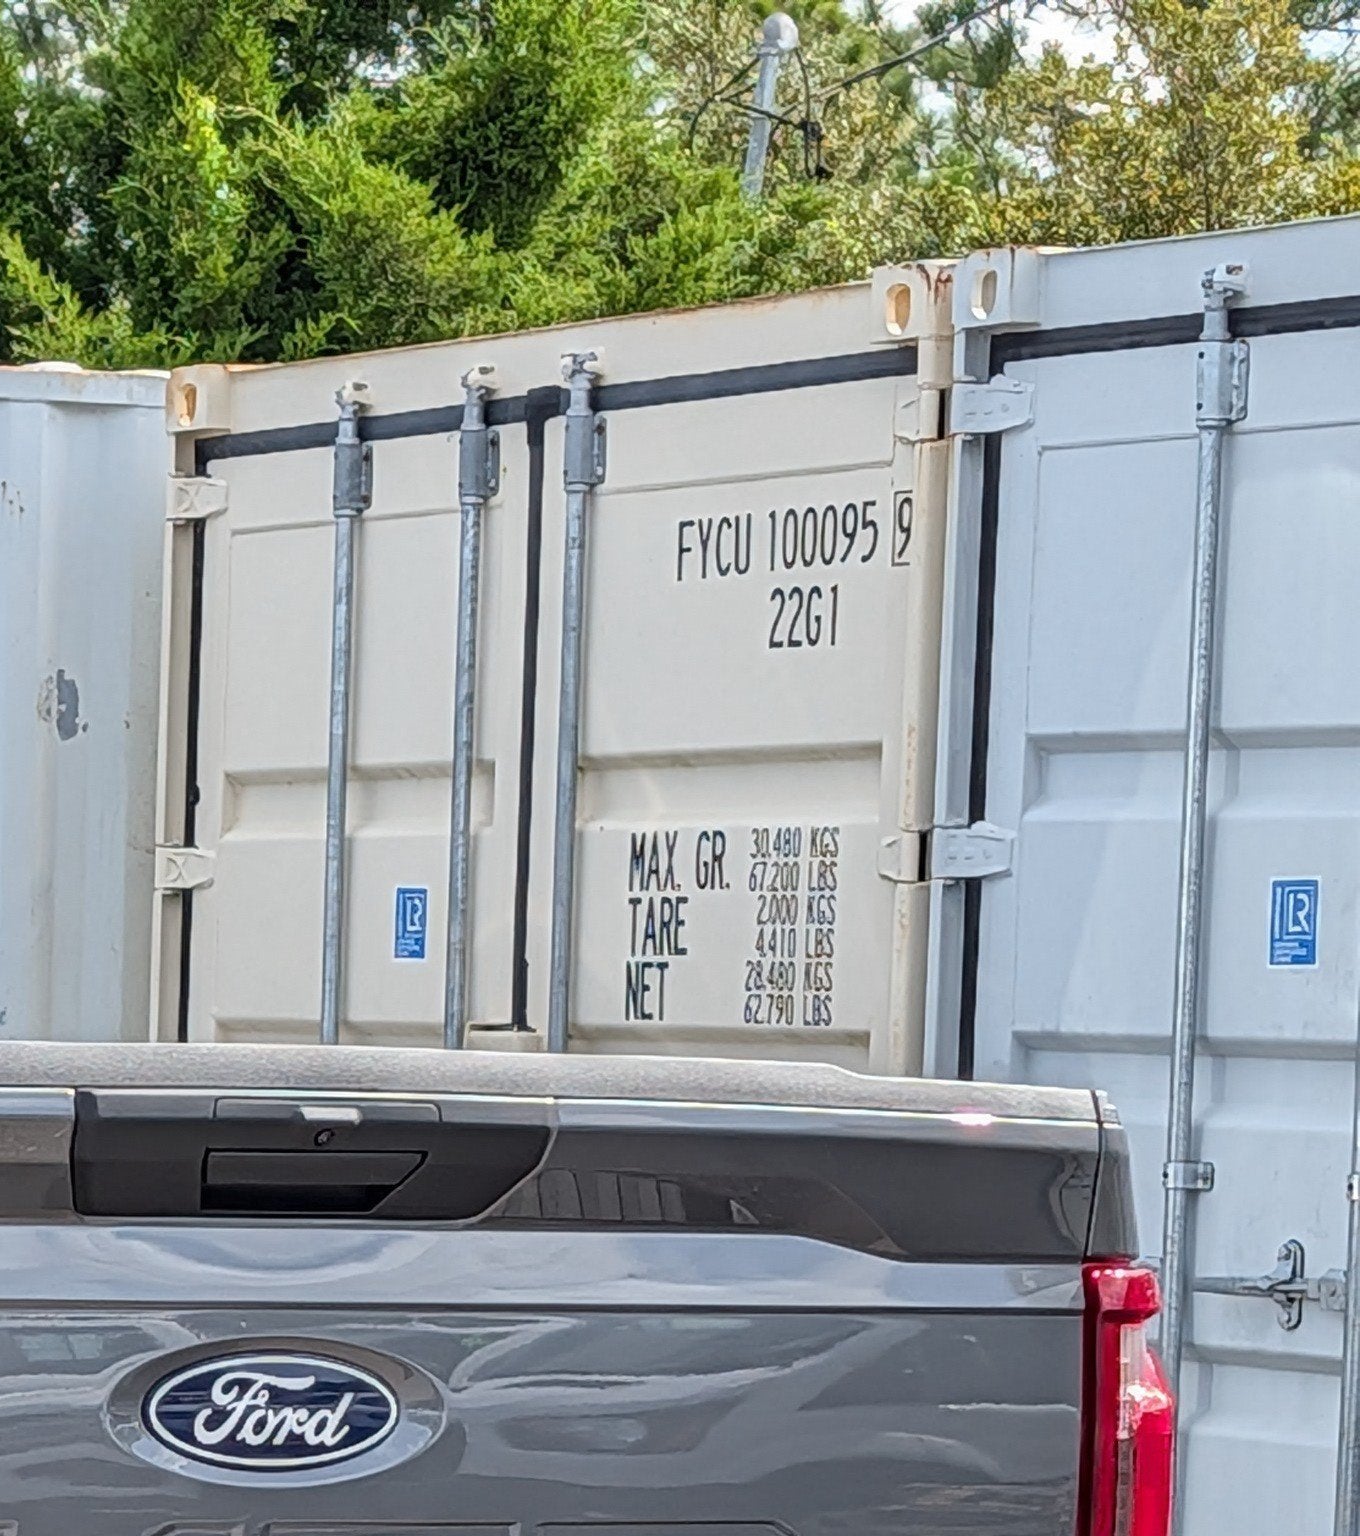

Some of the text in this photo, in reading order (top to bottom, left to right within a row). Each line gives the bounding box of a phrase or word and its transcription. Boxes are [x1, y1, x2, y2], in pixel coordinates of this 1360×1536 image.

[677, 491, 913, 581] FYCU 100095 9
[769, 584, 838, 649] 22G1
[628, 831, 682, 892] MAX.
[695, 830, 730, 890] GR.
[809, 826, 840, 858] KGS
[808, 861, 837, 892] LBS
[628, 896, 689, 957] TARE
[806, 894, 836, 926] KGS
[805, 928, 834, 958] LBS
[625, 961, 669, 1021] NET
[803, 961, 833, 992] KGS
[803, 995, 832, 1026] LBS
[192, 1372, 355, 1453] Ford
